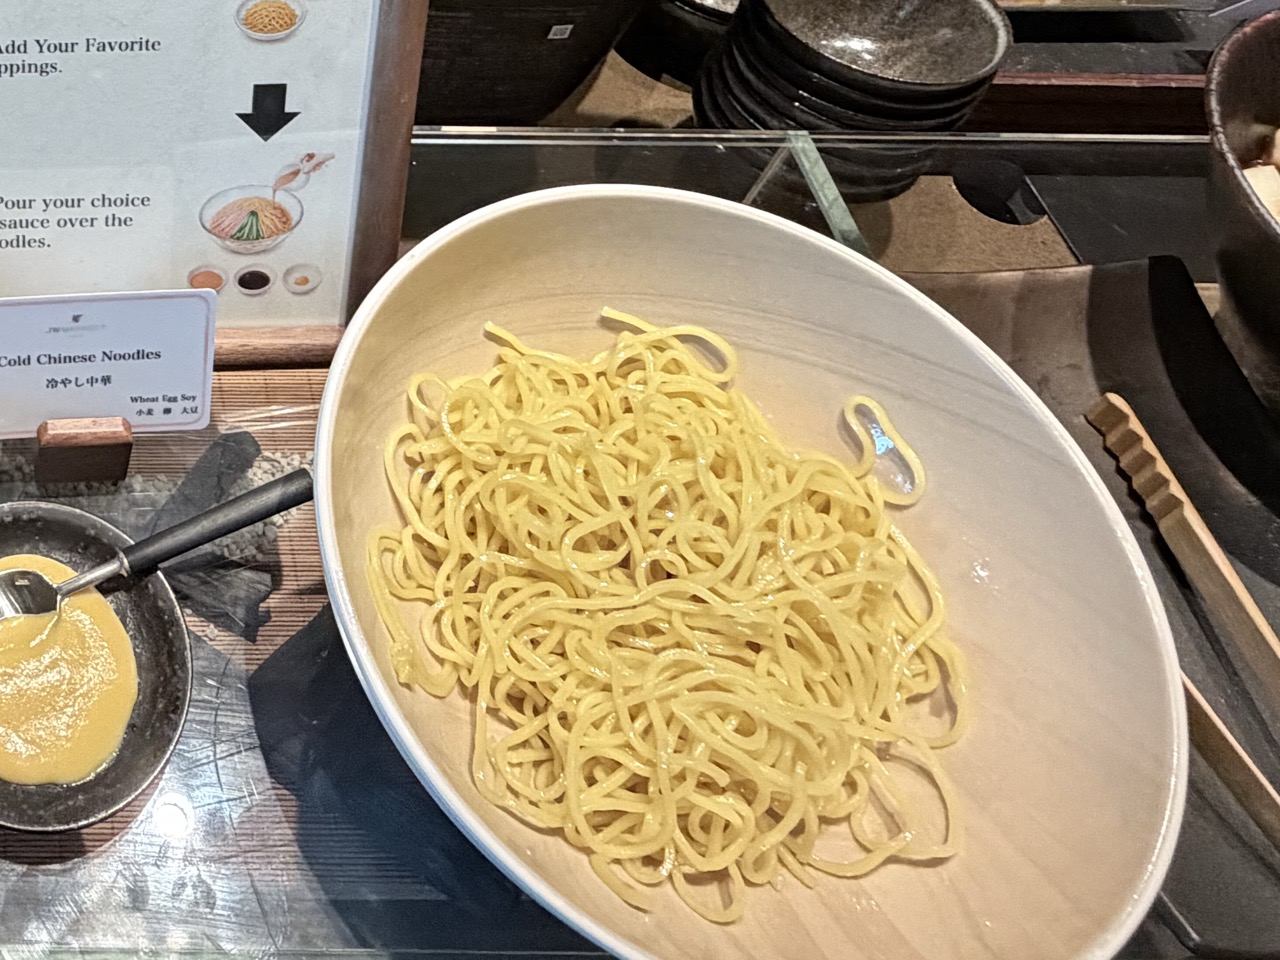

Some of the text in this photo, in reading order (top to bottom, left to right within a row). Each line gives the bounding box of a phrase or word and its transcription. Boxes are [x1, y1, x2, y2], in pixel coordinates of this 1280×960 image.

[33, 39, 79, 54] Your
[84, 37, 161, 53] Favorite
[42, 197, 85, 212] your
[90, 194, 151, 208] choice
[0, 218, 50, 230] sauce
[56, 217, 98, 228] over
[104, 213, 133, 227] the
[36, 352, 97, 365] Chinese
[101, 349, 162, 363] Noodles
[45, 374, 113, 390] 冷やし中華
[130, 393, 198, 404] Wheat Egg Soy
[180, 405, 200, 415] 大豆
